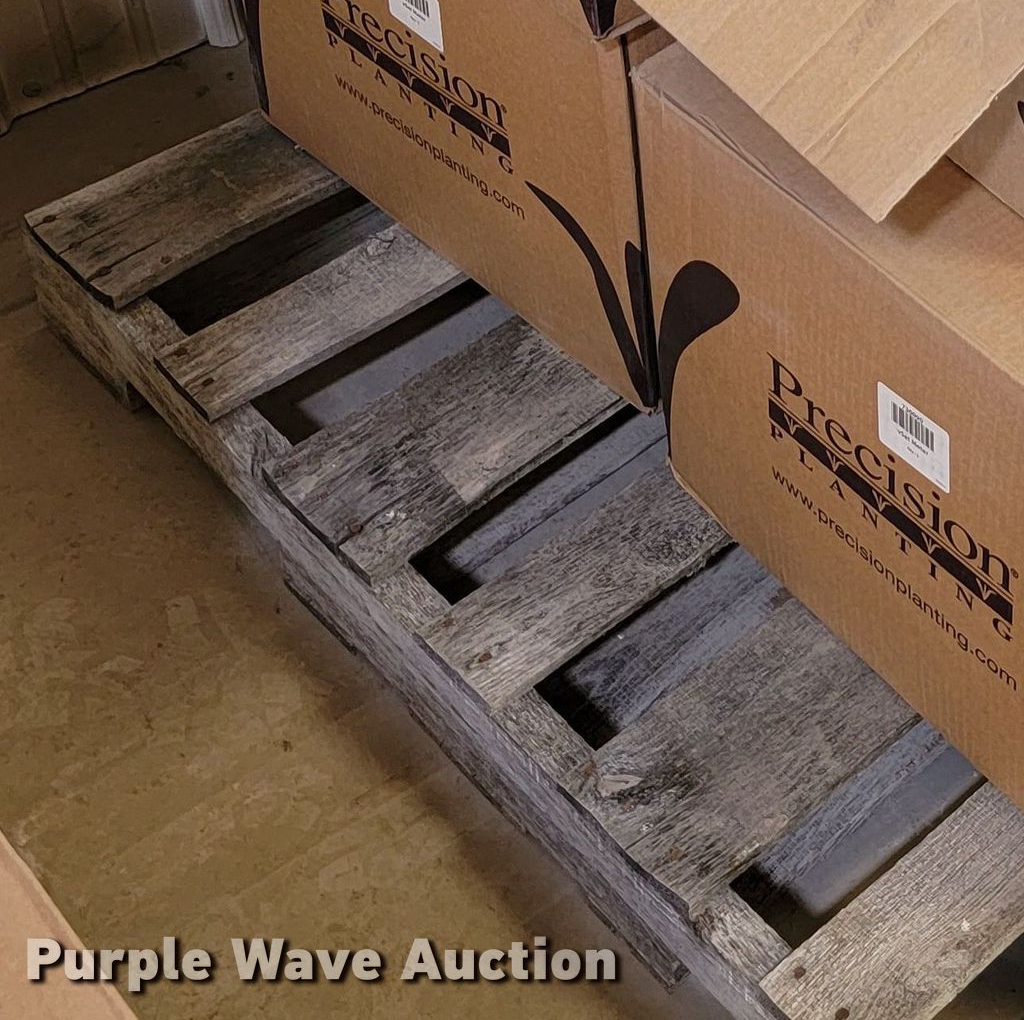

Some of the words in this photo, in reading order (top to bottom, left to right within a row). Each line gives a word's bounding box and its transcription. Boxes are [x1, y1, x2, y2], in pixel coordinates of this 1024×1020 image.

[327, 31, 514, 175] PLANTING
[334, 74, 526, 220] www.precisionplanting.com
[769, 422, 1013, 642] PLANTING
[772, 466, 1018, 691] www.precisionplanting.com
